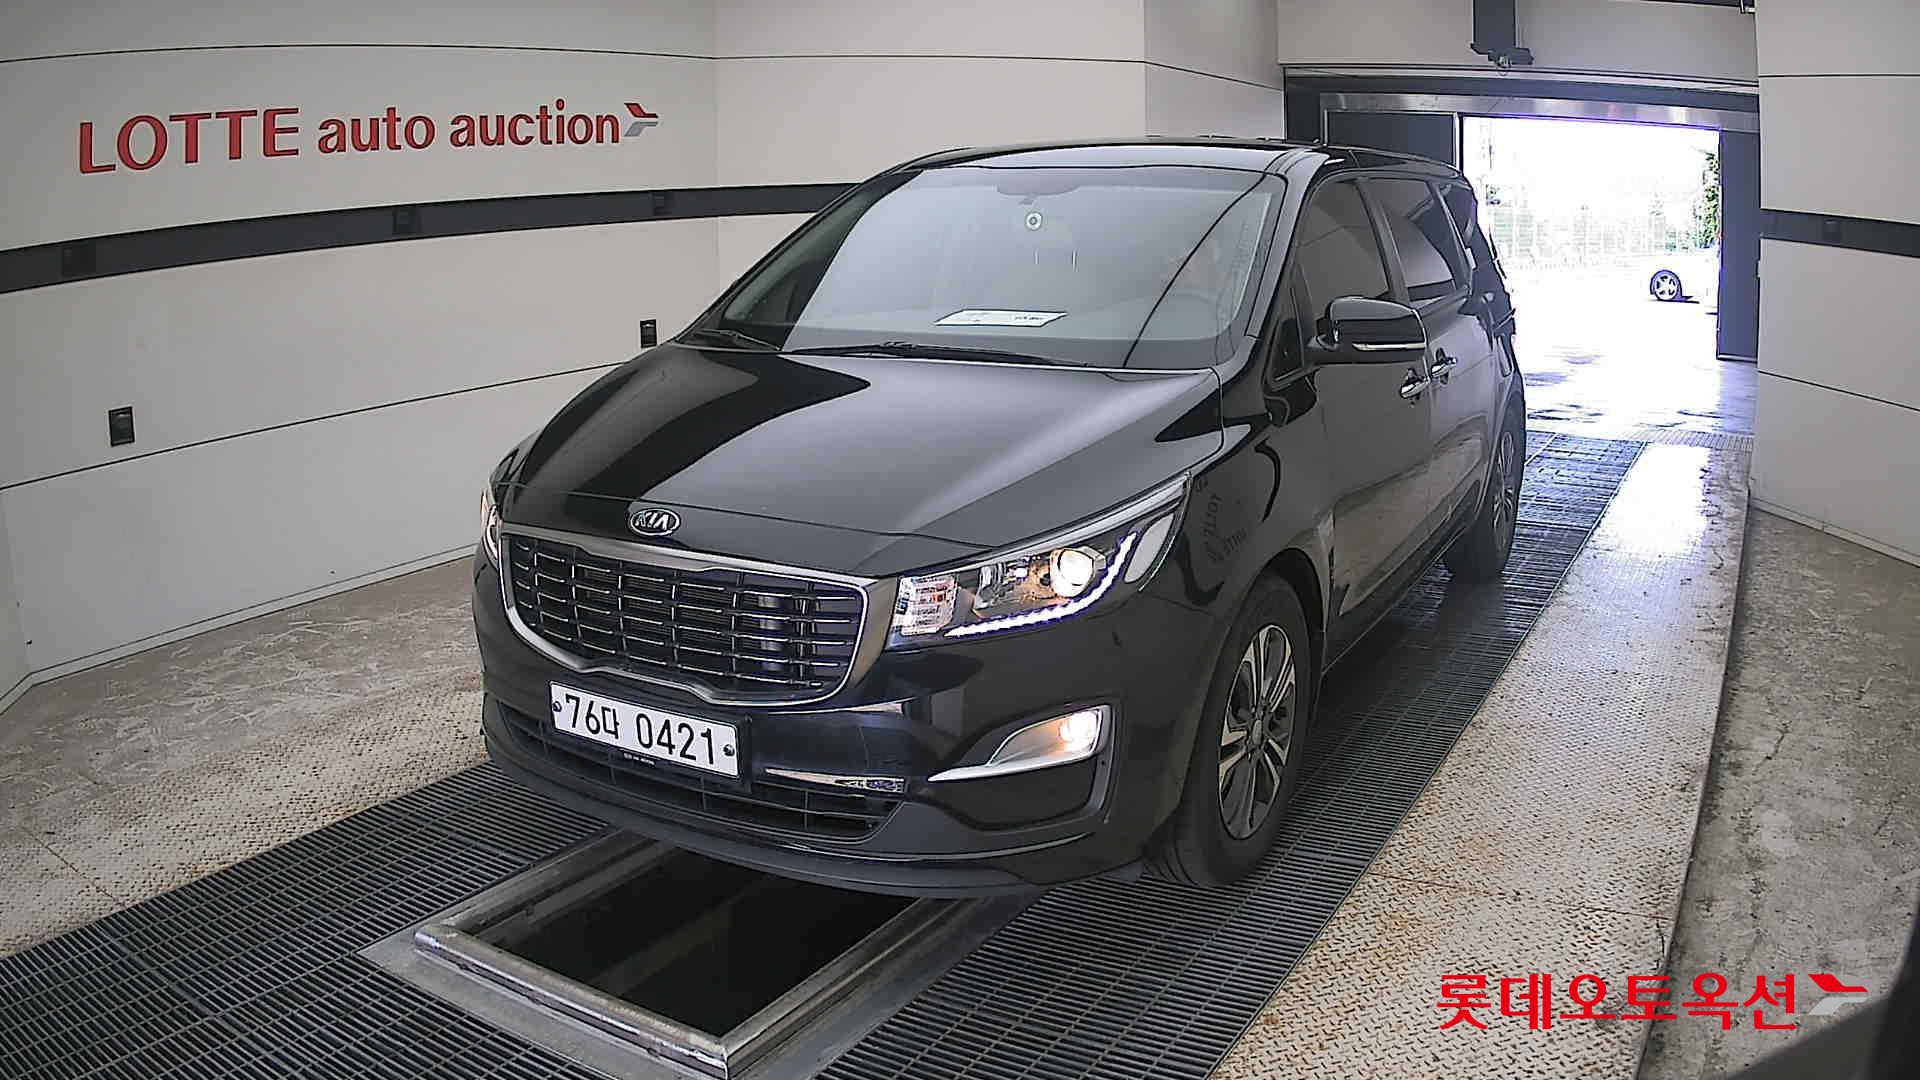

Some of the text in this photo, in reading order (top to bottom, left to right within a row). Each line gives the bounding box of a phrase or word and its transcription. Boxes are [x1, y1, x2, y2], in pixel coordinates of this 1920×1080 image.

[80, 99, 621, 174] LOTTE auto auction
[634, 511, 670, 531] KIA
[565, 693, 714, 765] 76다 0421
